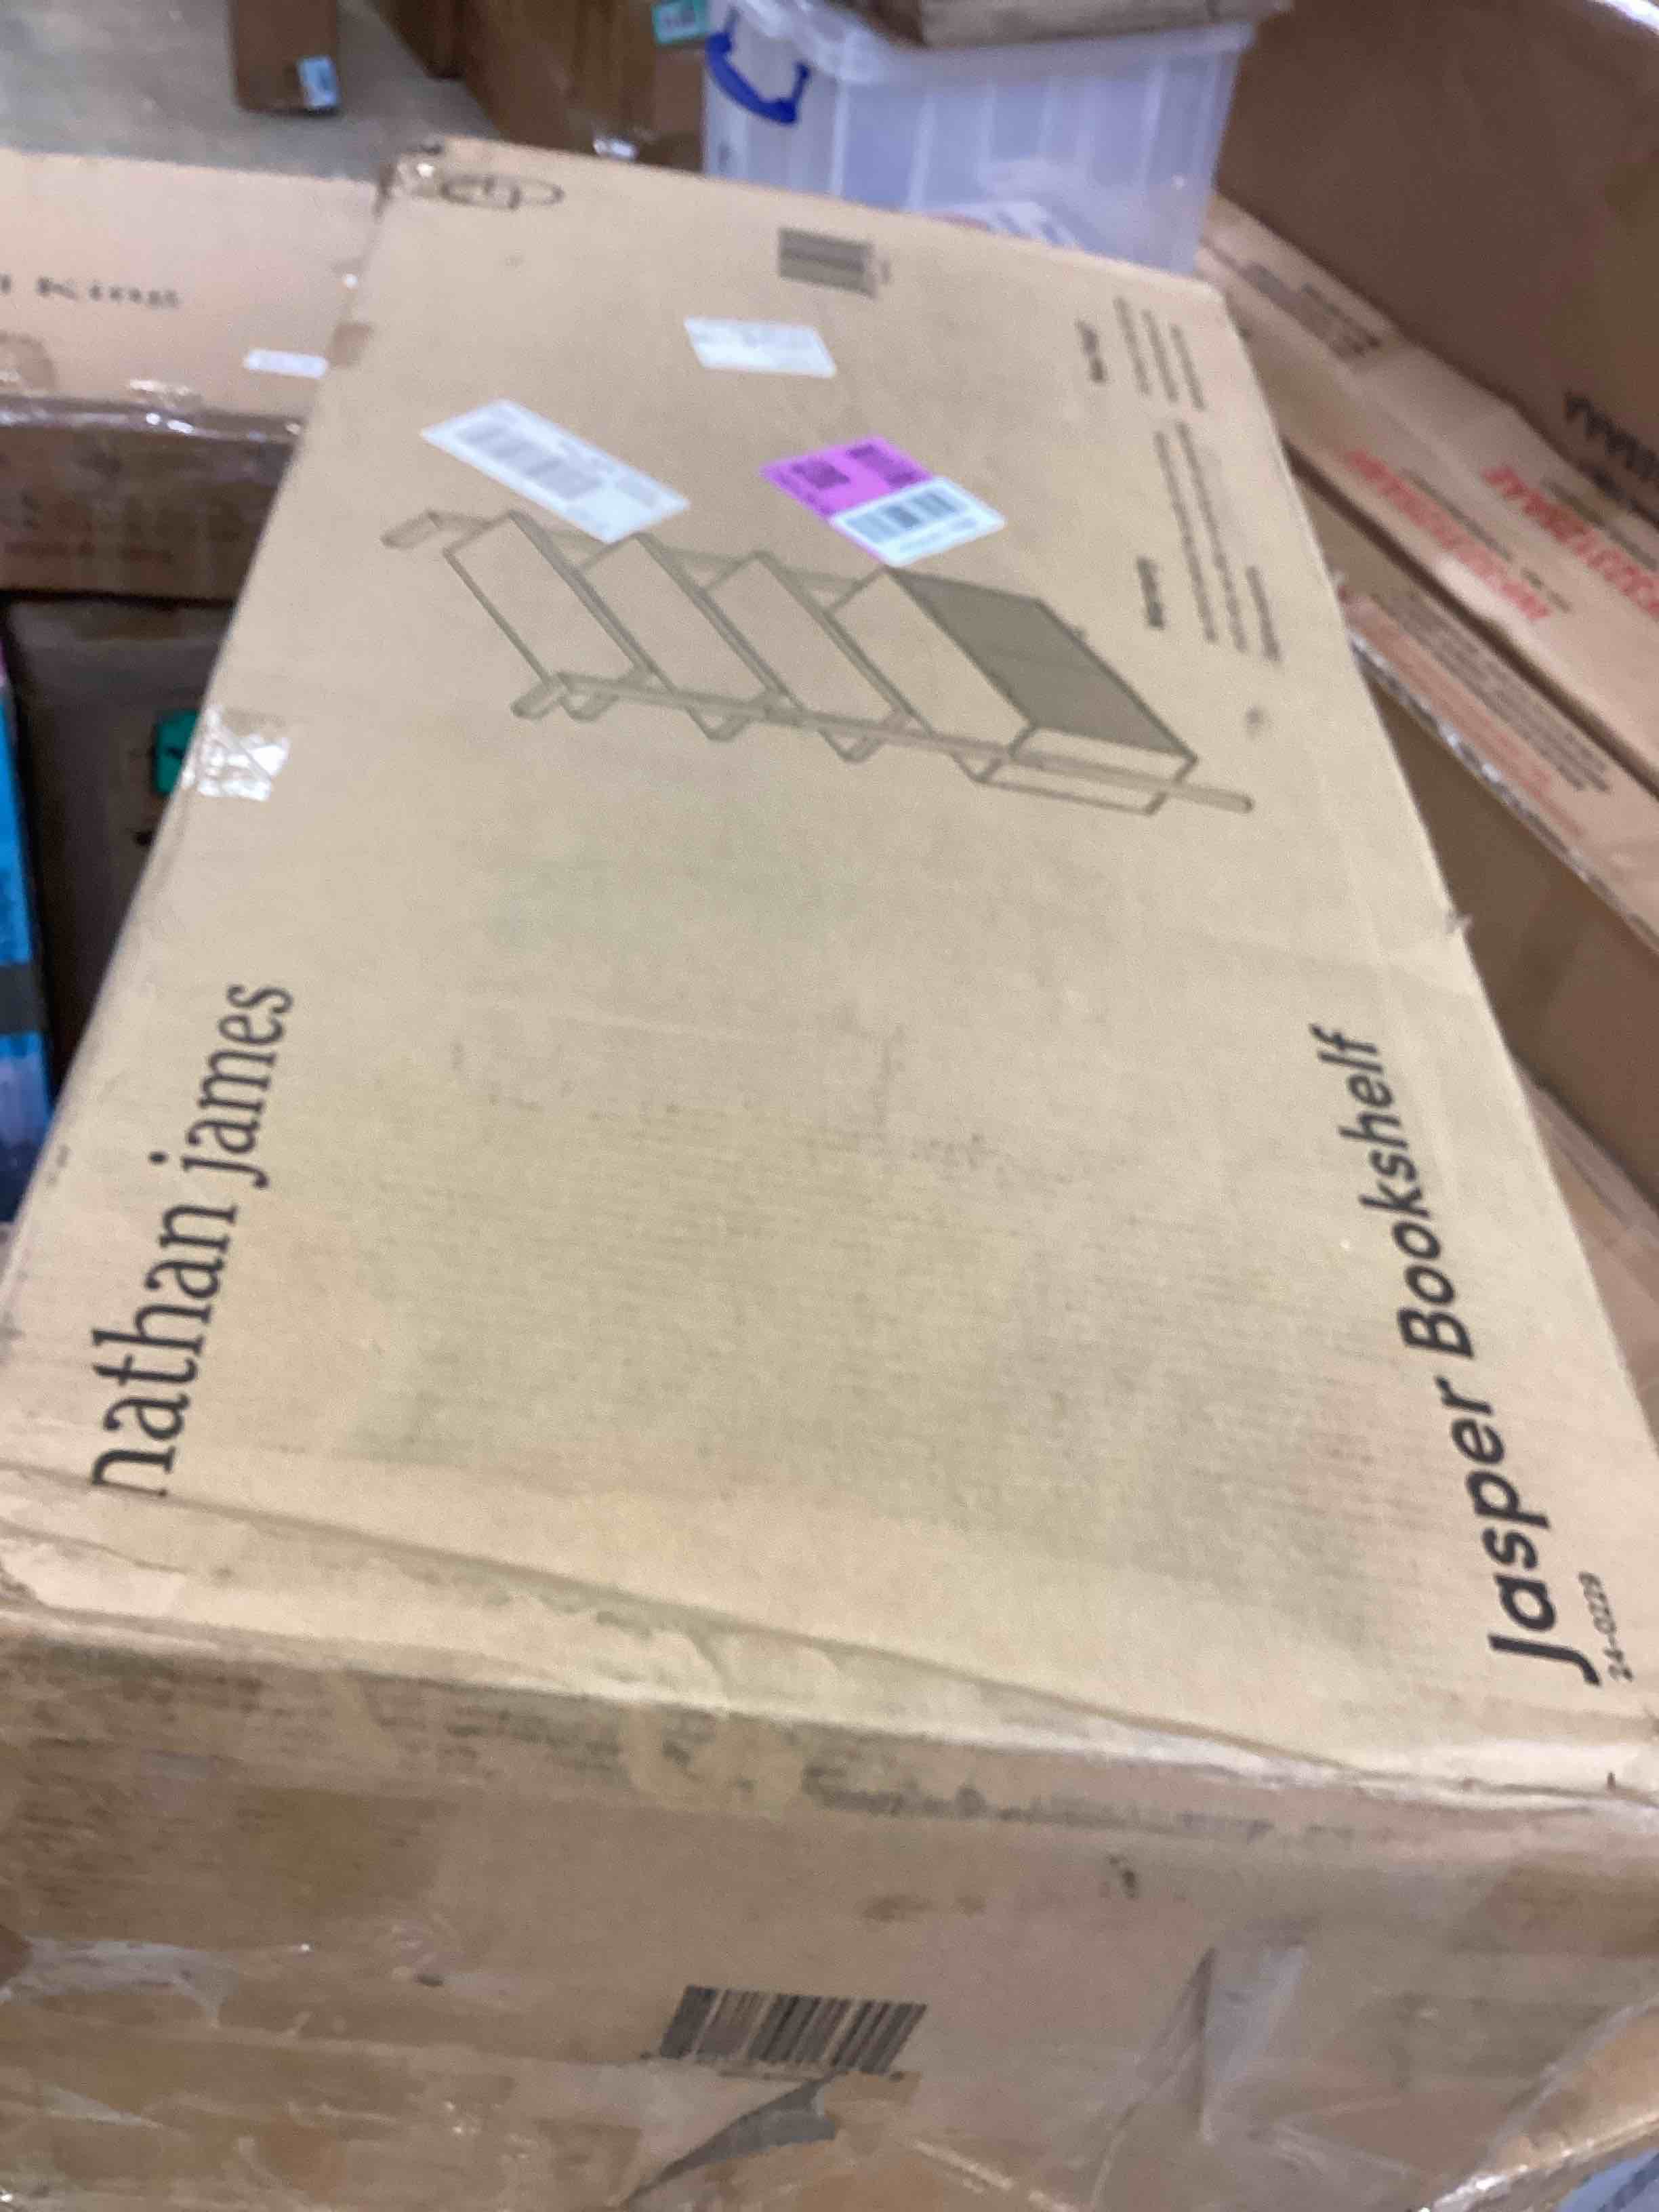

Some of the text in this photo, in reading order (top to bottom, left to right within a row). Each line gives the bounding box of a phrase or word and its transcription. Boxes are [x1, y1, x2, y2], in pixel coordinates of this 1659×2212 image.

[88, 985, 293, 1499] nathan james
[1311, 1023, 1602, 1687] Jasper Bookshelf
